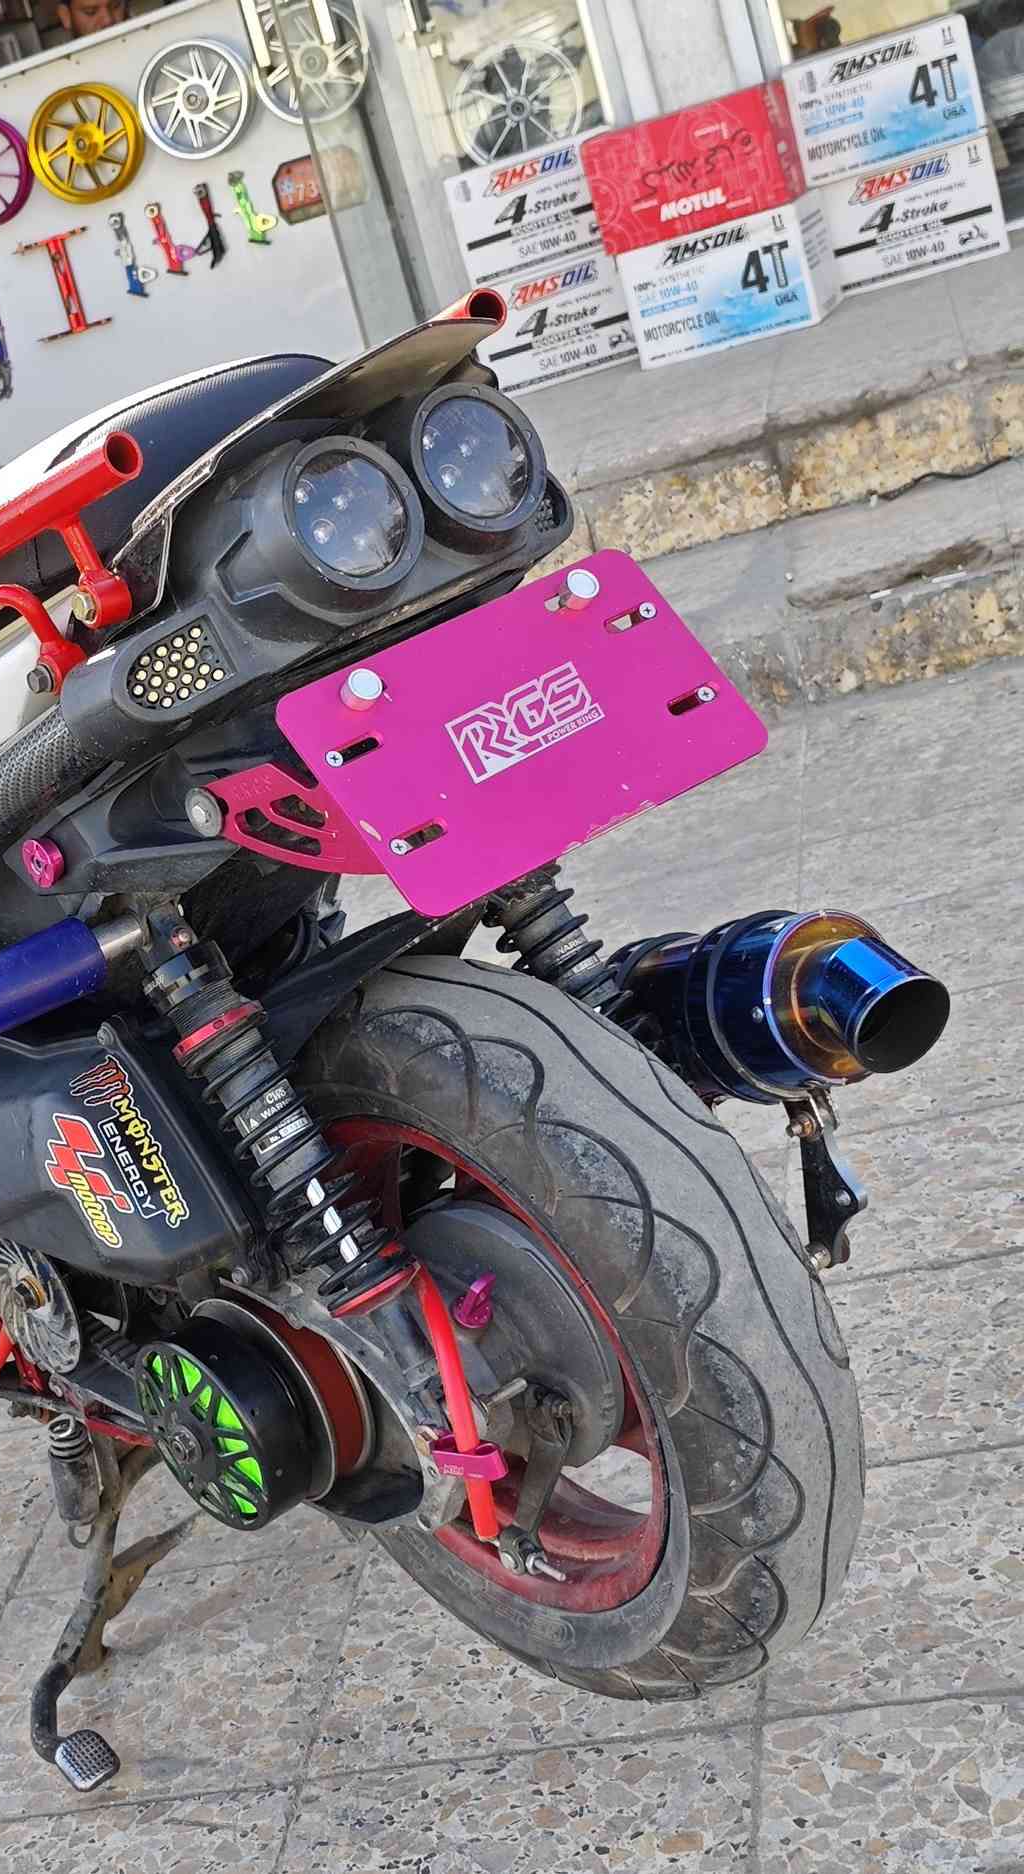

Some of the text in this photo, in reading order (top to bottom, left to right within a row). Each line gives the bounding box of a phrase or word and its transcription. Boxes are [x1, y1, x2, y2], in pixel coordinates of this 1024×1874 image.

[829, 37, 918, 83] AMSOIL
[909, 54, 958, 108] 4T
[807, 131, 869, 162] MOTORCYCLE
[484, 146, 578, 198] AMSOIL
[851, 154, 950, 205] AMSOIL
[660, 186, 727, 222] MOTUL
[660, 224, 750, 268] AMSOIL
[741, 240, 788, 293] 4T
[510, 261, 598, 309] AMSOIL
[643, 315, 704, 343] MOTORCYCLE
[559, 343, 598, 364] 10W-40
[545, 709, 600, 742] POWER KING
[103, 1121, 157, 1211] ENERGY
[115, 1097, 188, 1225] MONSTER
